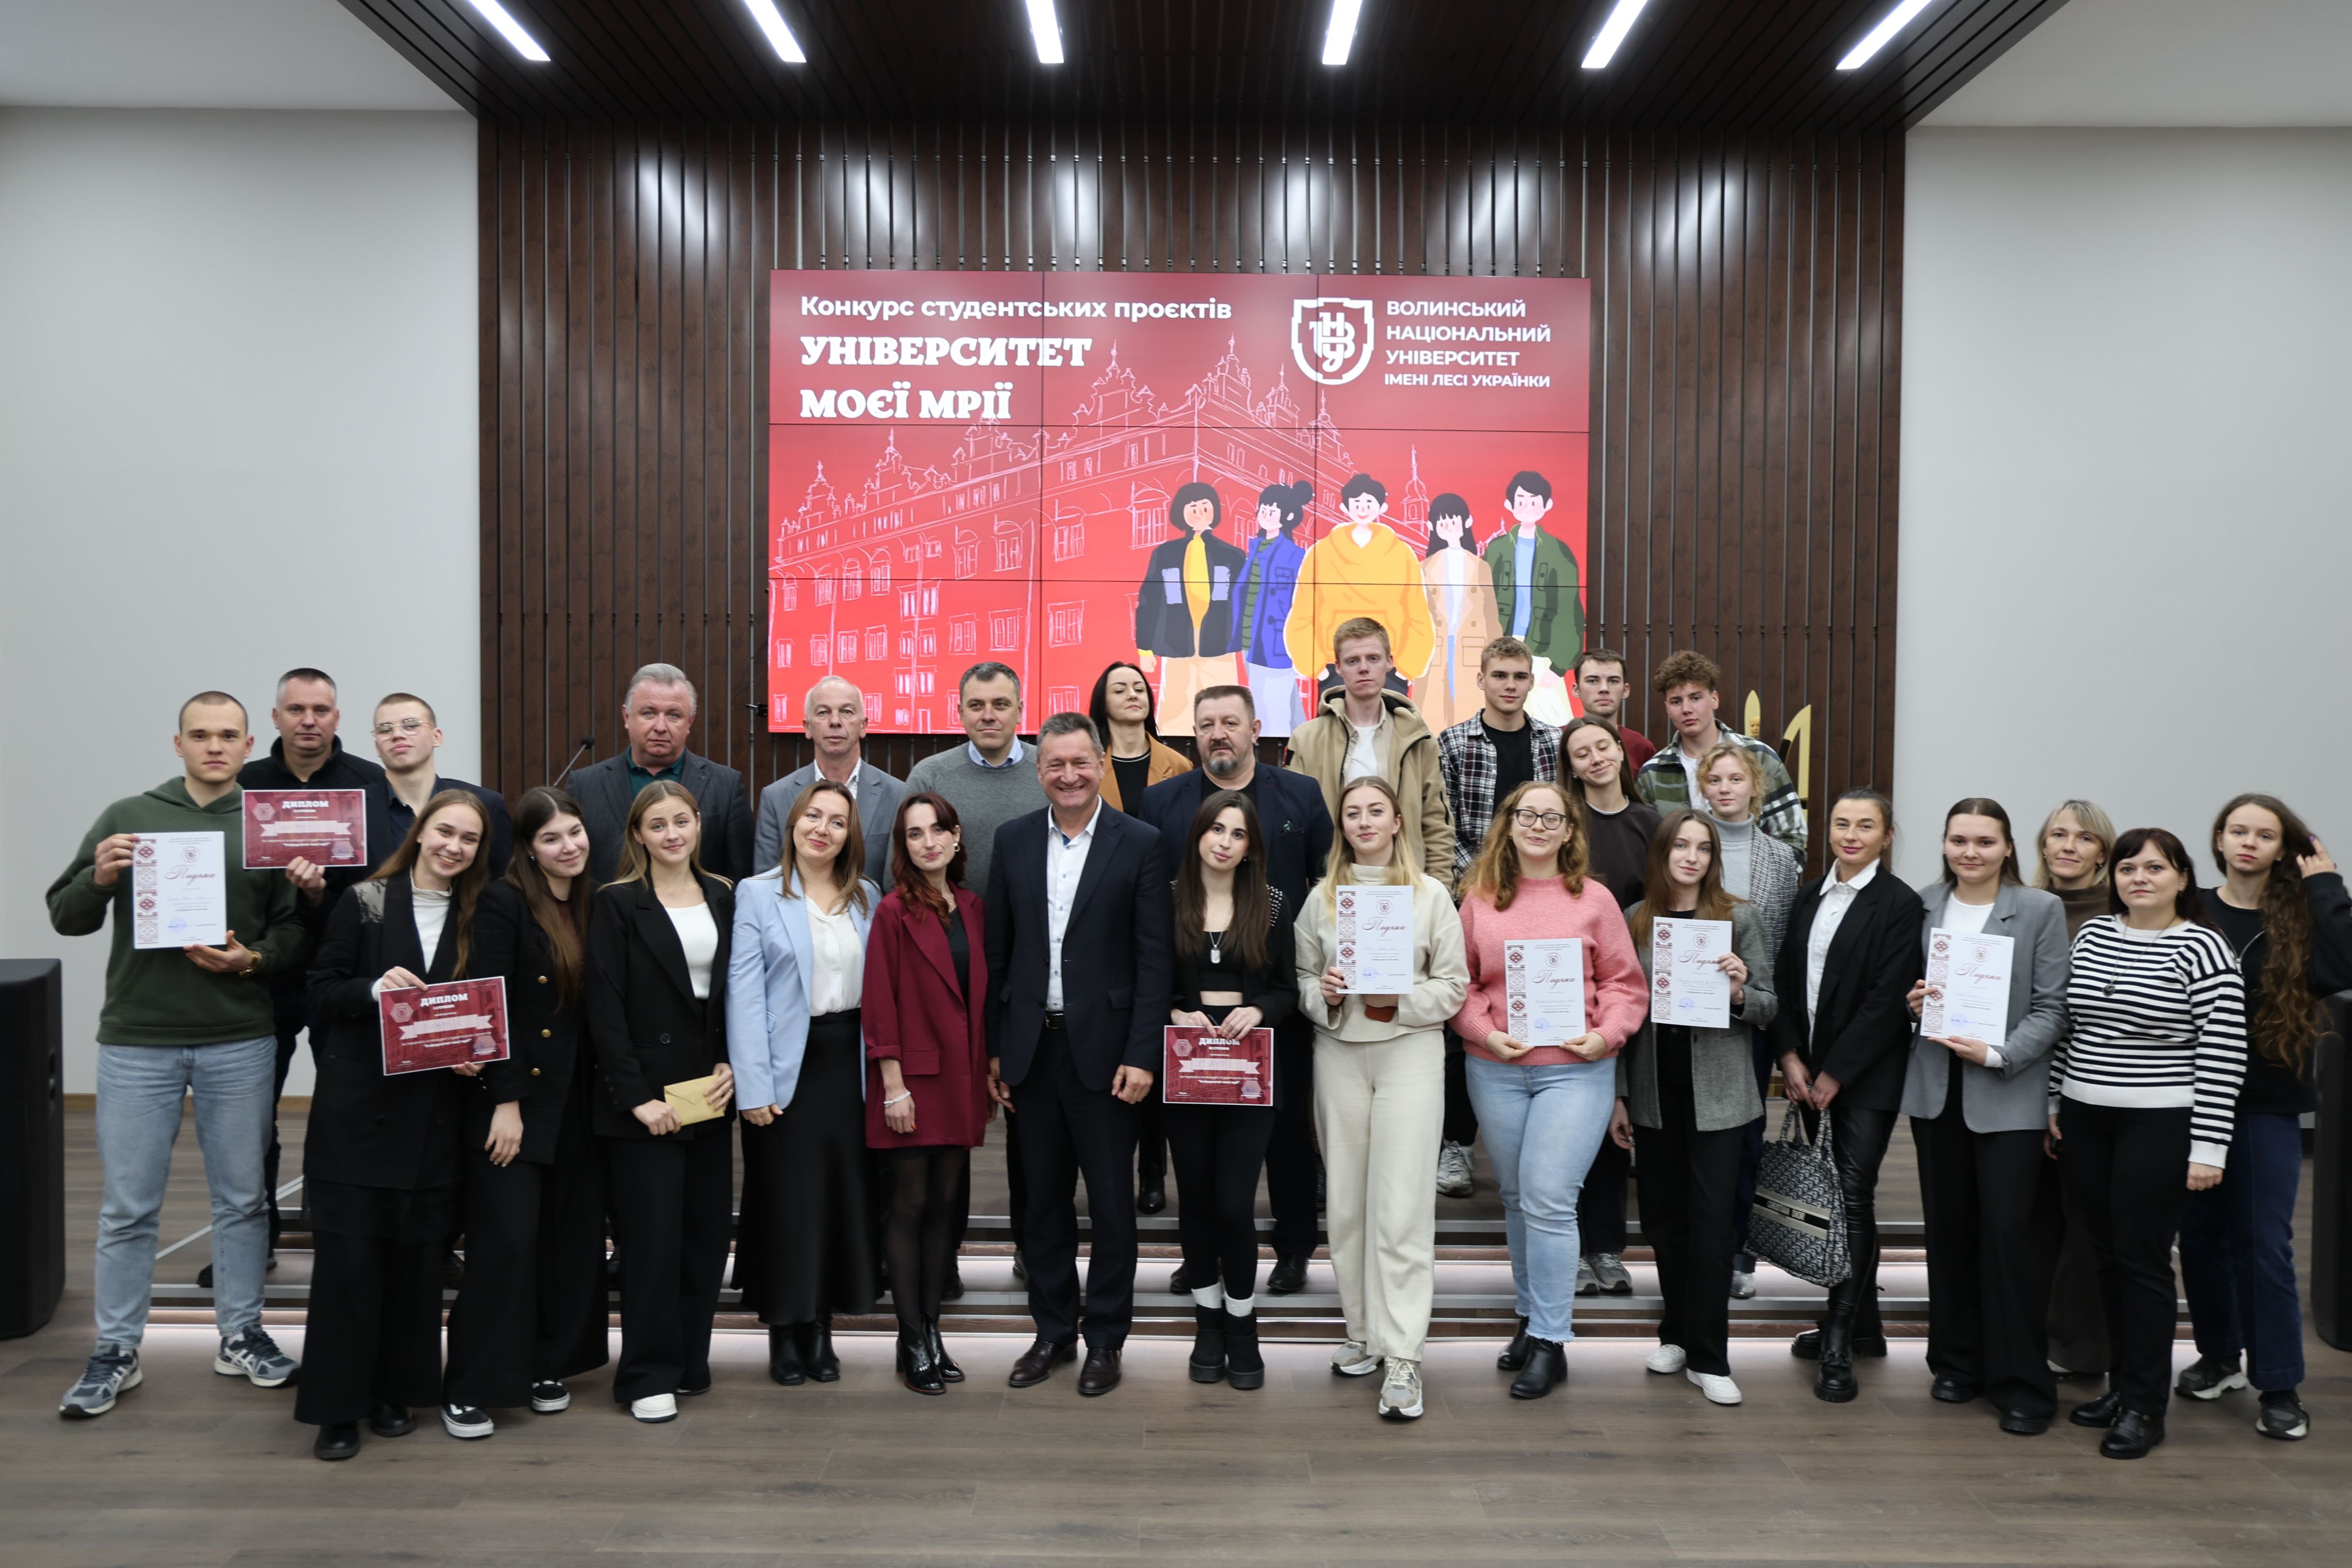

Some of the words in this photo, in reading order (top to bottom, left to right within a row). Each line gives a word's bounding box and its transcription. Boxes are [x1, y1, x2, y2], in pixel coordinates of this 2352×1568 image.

[800, 296, 915, 321] Конкурс
[920, 300, 1108, 322] студентських
[1114, 297, 1233, 323] проєктів
[1387, 299, 1526, 318] ВОЛИНСЬКИЙ
[1386, 324, 1552, 344] НАЦІОНАЛЬНИЙ
[800, 336, 1093, 367] УНІВЕРСИТЕТ
[1386, 350, 1521, 367] УНІВЕРСИТЕТ
[1384, 373, 1429, 386] ІМЕНІ
[1432, 374, 1469, 387] ЛЕСІ
[1472, 372, 1551, 388] УКРАЇНКИ
[800, 381, 912, 419] МОЄЇ
[919, 382, 1014, 420] МРІЇ
[282, 800, 330, 810] ДИПЛОМ
[420, 993, 469, 1007] ДИПЛОМ
